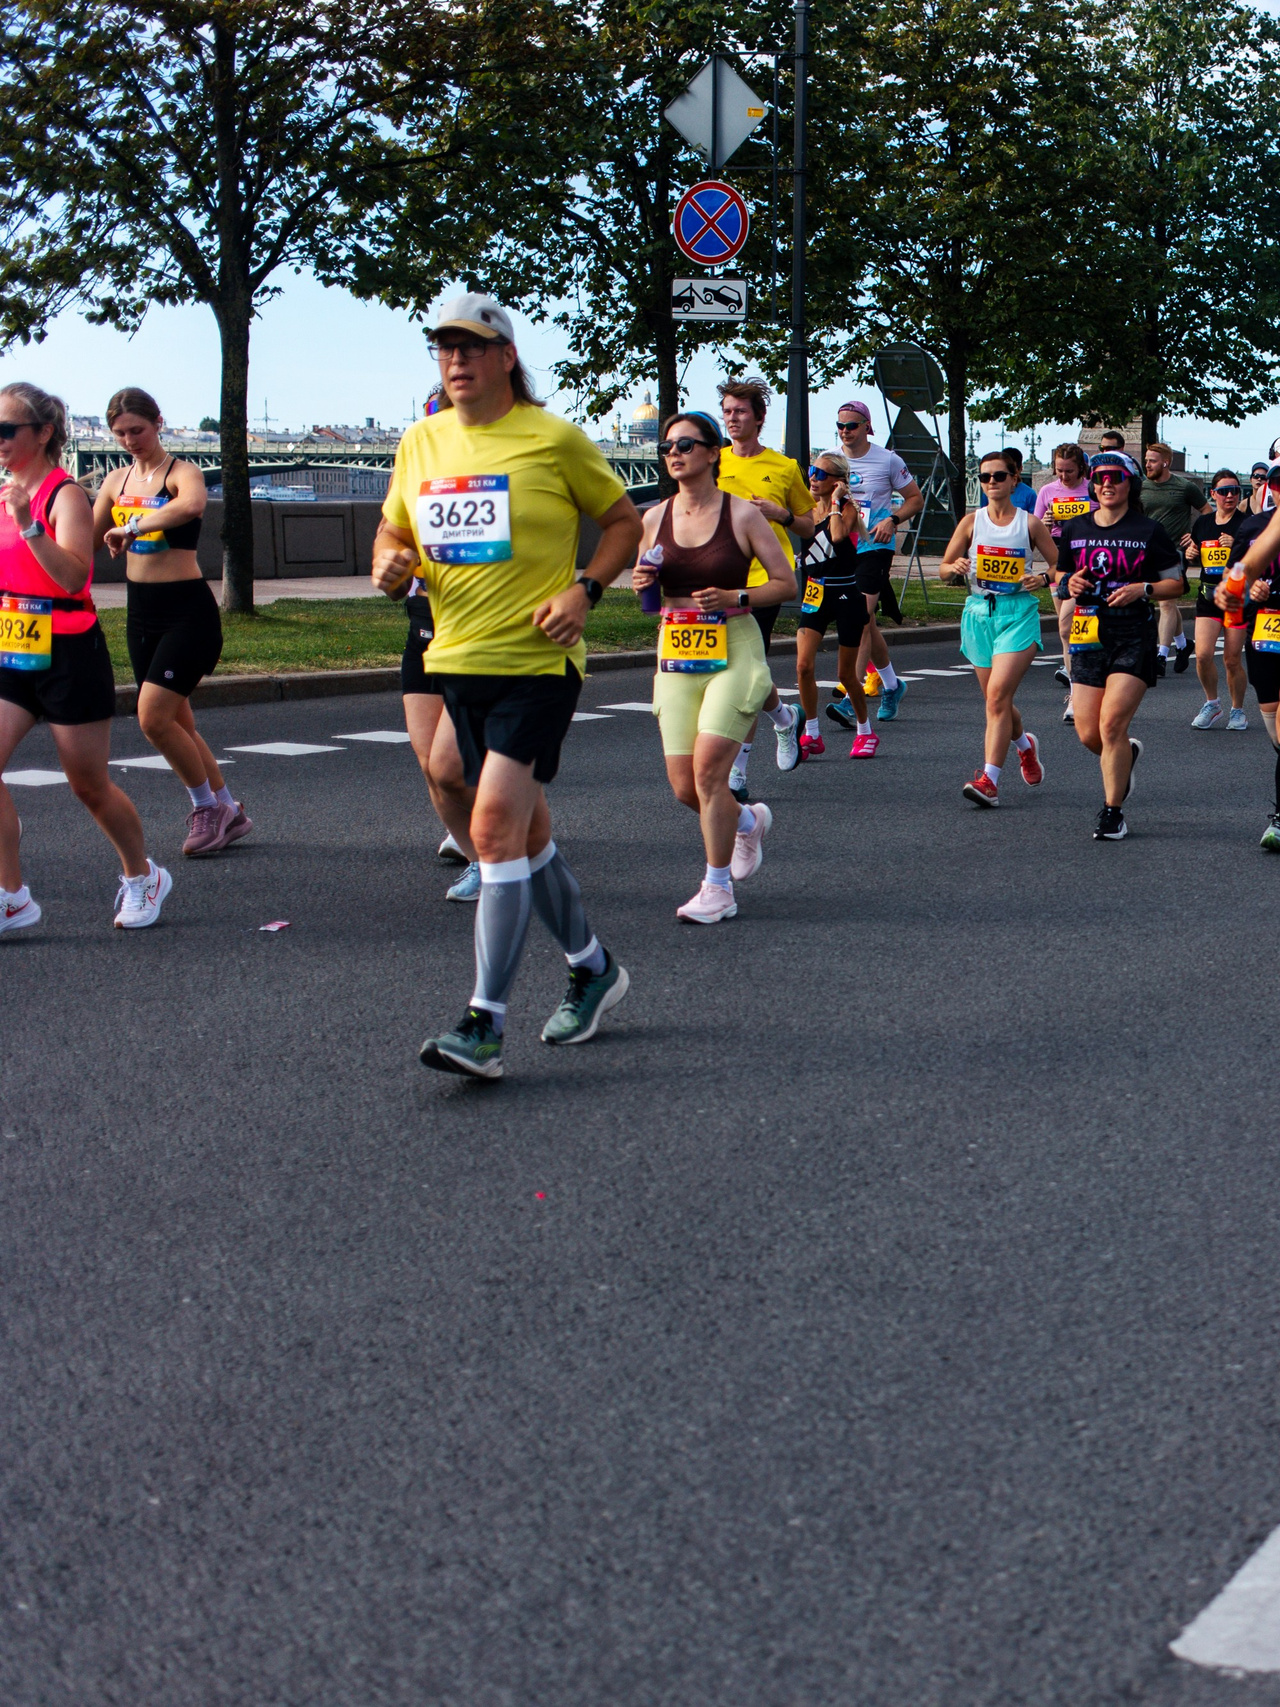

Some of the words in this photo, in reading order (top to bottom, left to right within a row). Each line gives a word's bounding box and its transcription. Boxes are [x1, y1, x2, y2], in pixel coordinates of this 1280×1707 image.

[429, 499, 496, 528] 3623
[1058, 504, 1085, 514] 5589
[442, 527, 485, 539] ДМИТРИЙ
[1088, 539, 1147, 549] MARATHON
[430, 546, 442, 561] E
[1208, 550, 1227, 561] 655
[982, 558, 1019, 575] 5876
[671, 629, 718, 648] 5875
[667, 660, 675, 671] E
